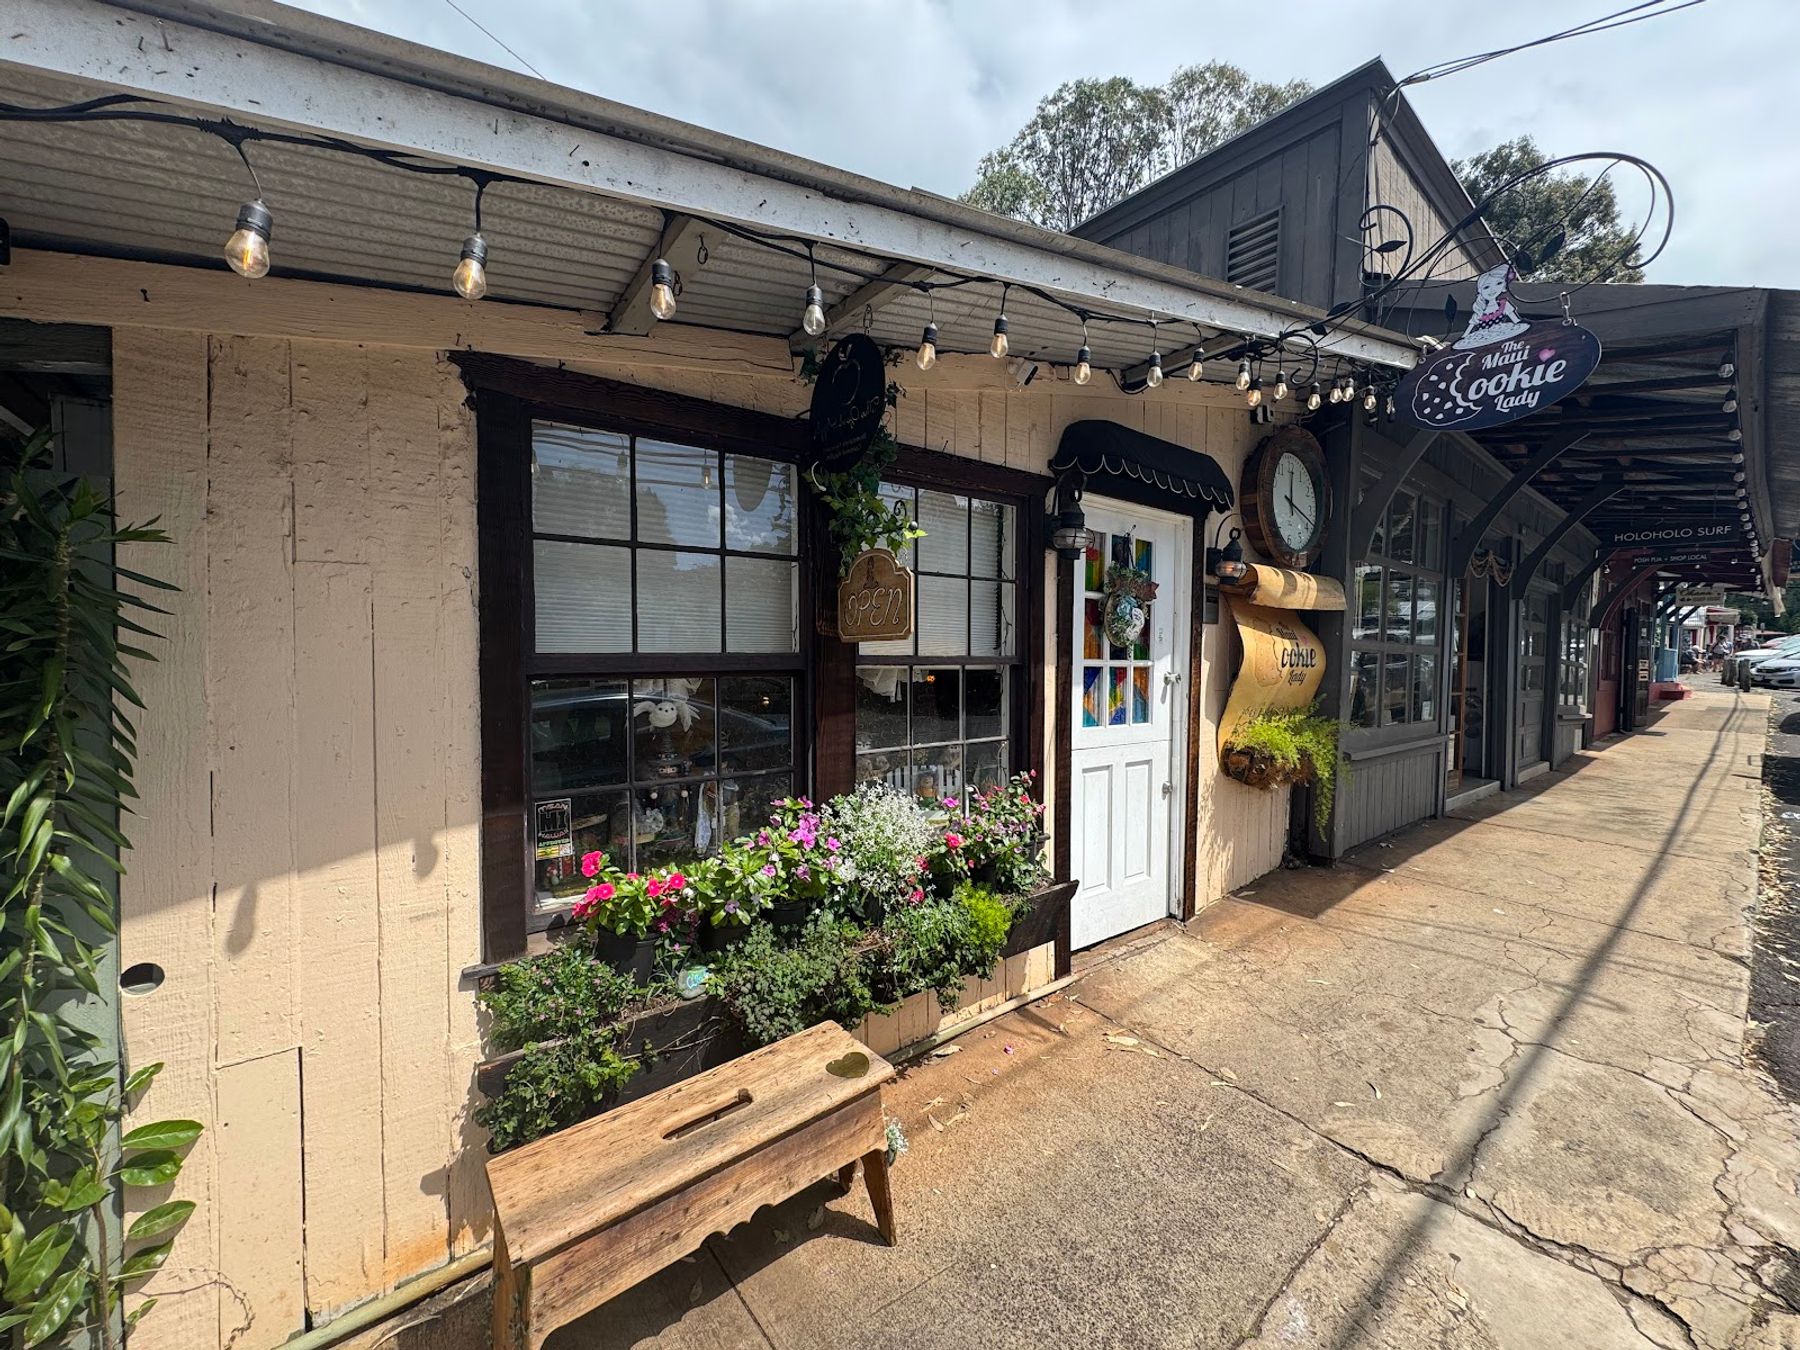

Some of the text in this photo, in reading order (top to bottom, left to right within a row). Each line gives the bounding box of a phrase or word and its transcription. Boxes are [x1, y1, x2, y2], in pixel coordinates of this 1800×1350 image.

[1481, 345, 1531, 371] Maui
[1501, 340, 1525, 353] The
[1494, 389, 1541, 413] Lady
[1614, 525, 1732, 542] HOLOHOLO SURF
[845, 587, 903, 627] OPEN
